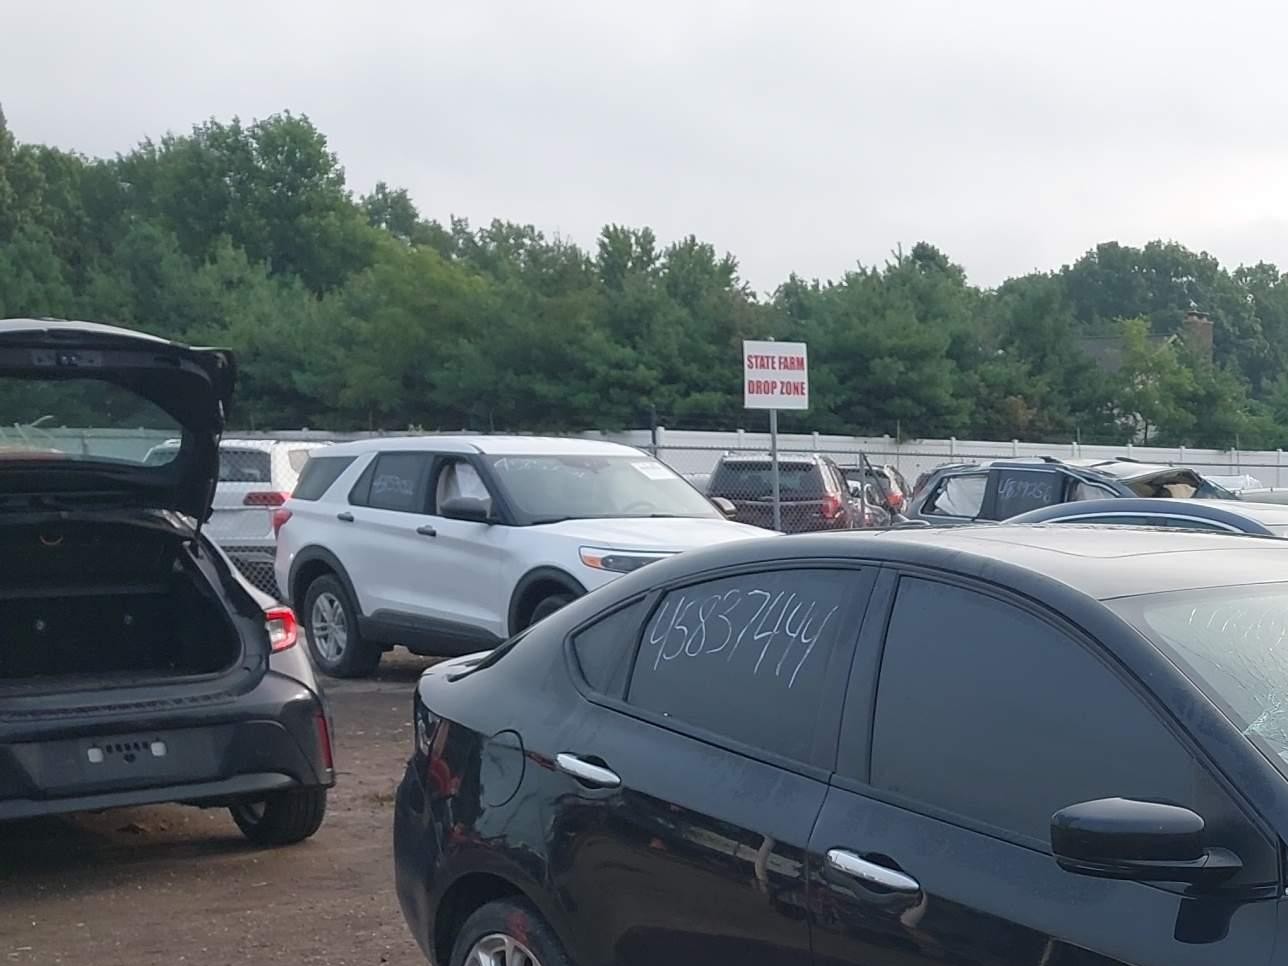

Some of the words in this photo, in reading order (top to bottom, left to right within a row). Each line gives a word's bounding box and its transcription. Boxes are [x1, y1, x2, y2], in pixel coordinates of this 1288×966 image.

[746, 354, 777, 370] STATE
[778, 355, 805, 371] FARM
[748, 379, 777, 395] DROP
[779, 381, 806, 396] ZONE
[650, 588, 839, 689] 45837444
